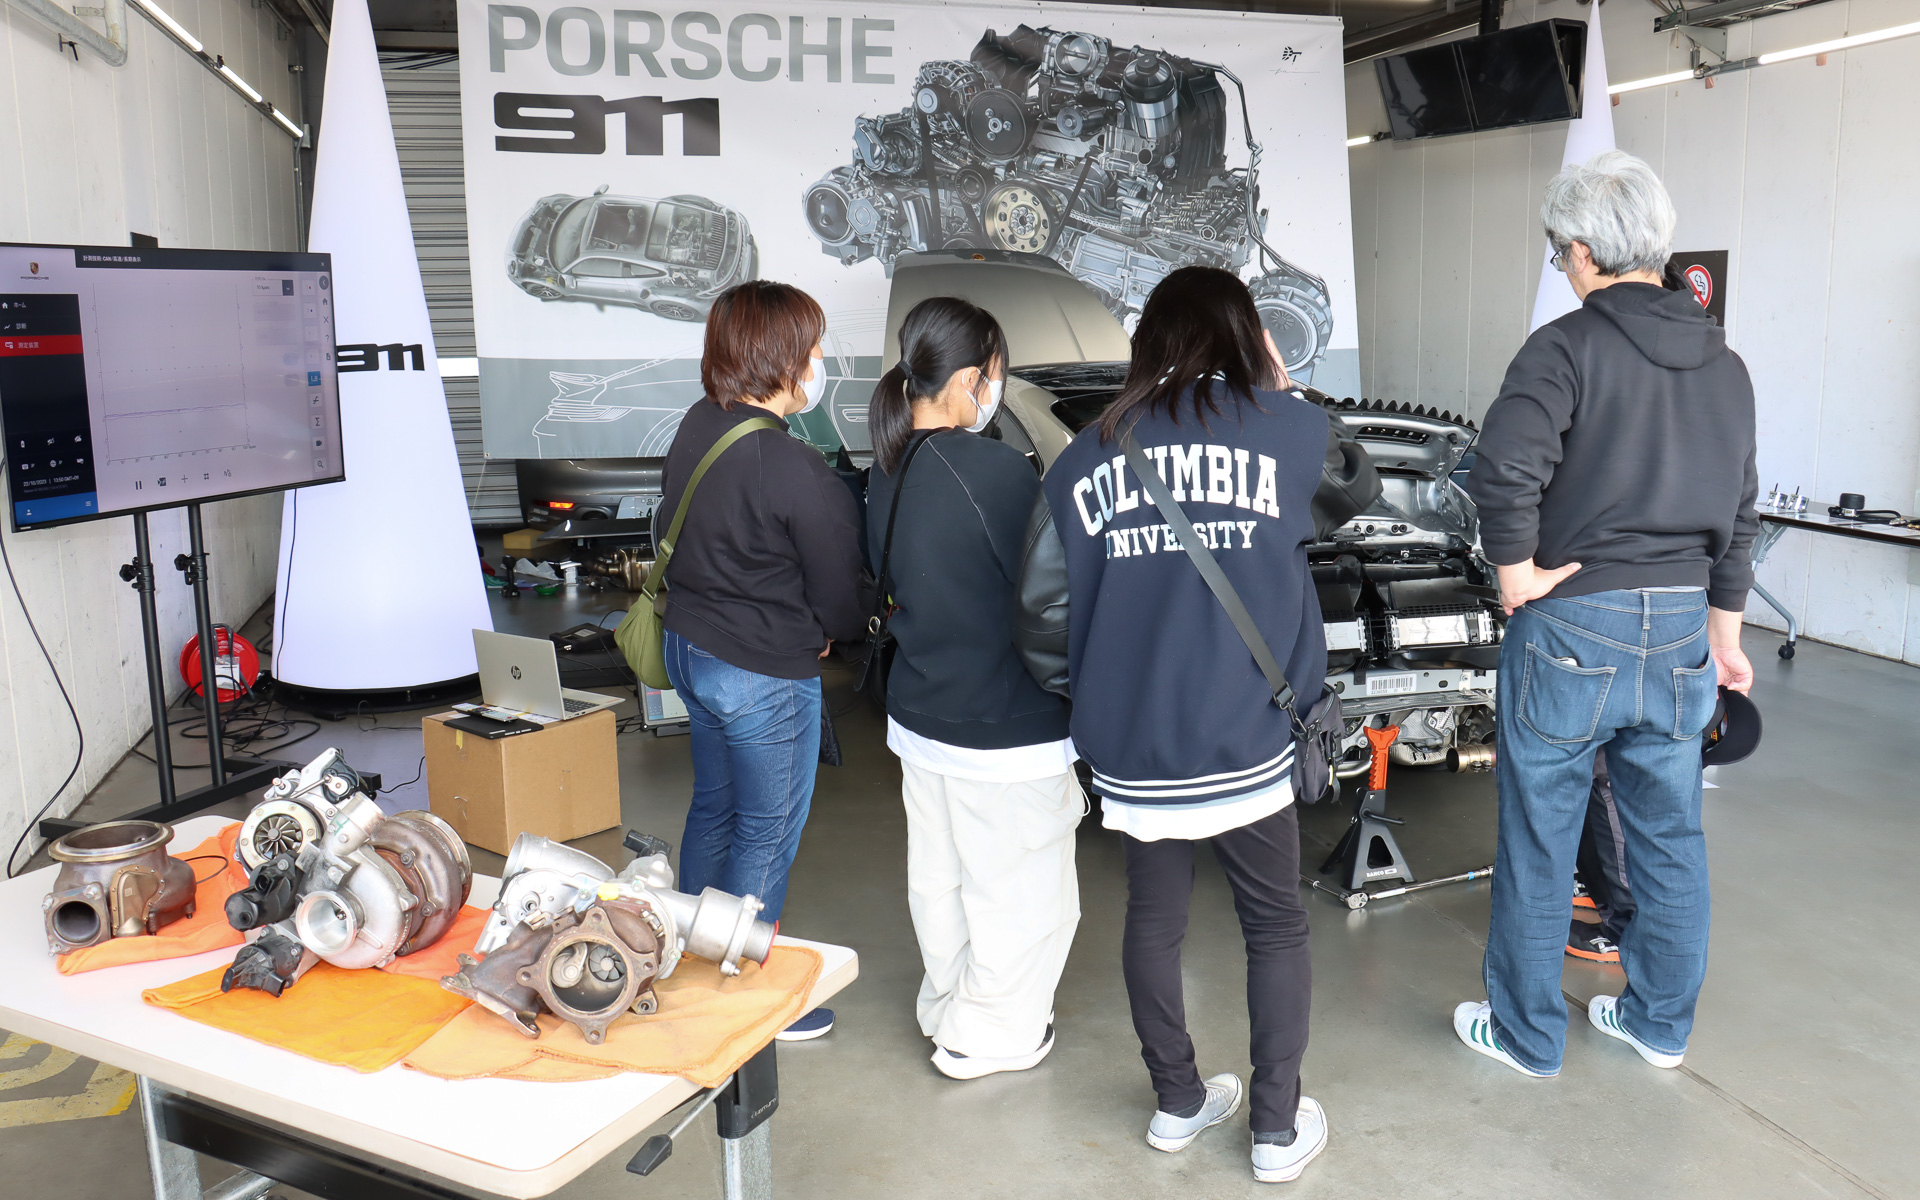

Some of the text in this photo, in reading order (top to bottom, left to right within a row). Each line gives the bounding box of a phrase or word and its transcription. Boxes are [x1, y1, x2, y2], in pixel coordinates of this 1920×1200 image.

[487, 4, 896, 84] PORSCHE
[493, 91, 721, 156] 911
[336, 343, 425, 373] 911
[1073, 443, 1280, 537] COLUMBIA
[1105, 520, 1257, 560] NIVESITY
